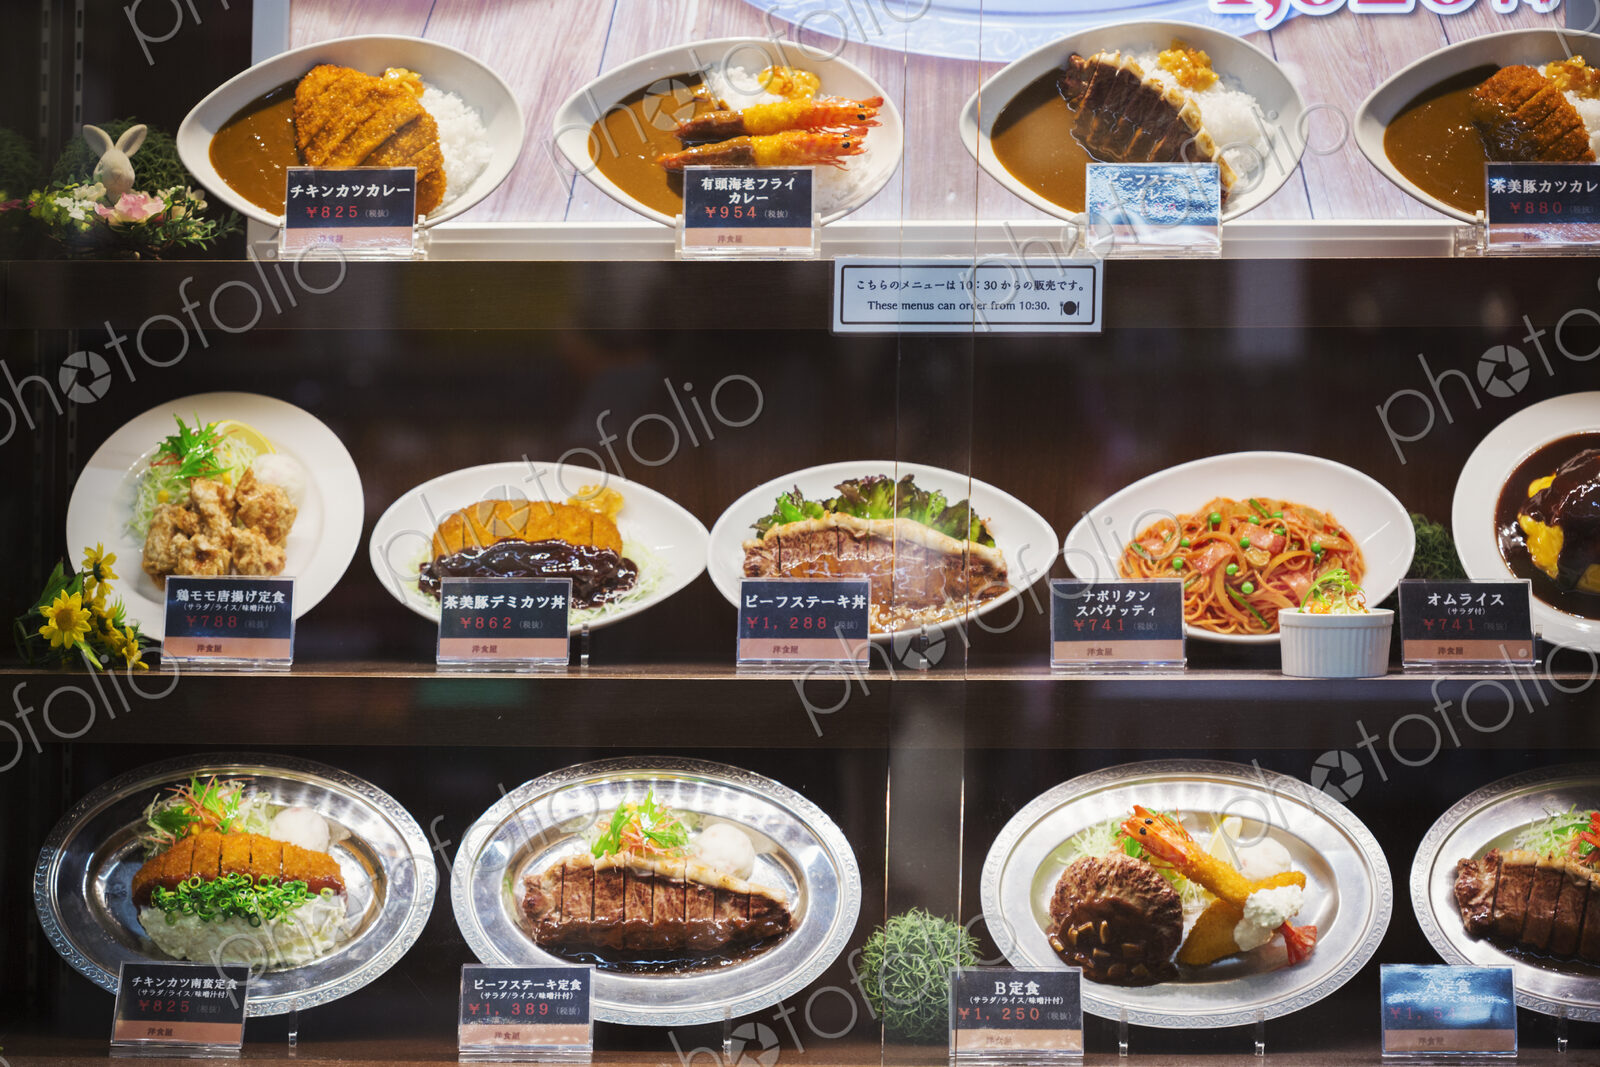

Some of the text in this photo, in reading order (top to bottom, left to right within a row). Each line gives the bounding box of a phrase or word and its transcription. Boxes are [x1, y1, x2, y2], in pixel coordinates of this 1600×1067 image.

[701, 177, 795, 191] 有頭海老フライ
[290, 184, 411, 198] チキンカツカレー
[729, 192, 769, 204] カレー
[306, 206, 358, 218] ¥825
[705, 206, 757, 219] ¥954
[1510, 202, 1562, 214] ¥880
[867, 301, 1050, 311] These menus can order from 10:30.
[176, 588, 286, 604] 鶏モモ唐揚げ定食
[444, 595, 566, 609] 茶美豚デミカツ丼
[745, 594, 867, 609] ビーフステーキ丼
[1083, 590, 1151, 602] ナポリタン
[1427, 592, 1505, 606] オムライス
[1076, 604, 1156, 617] スパゲッティ
[186, 615, 238, 629] ¥788
[461, 617, 512, 629] ¥862
[1073, 619, 1124, 632] ¥741
[1424, 618, 1476, 631] ¥741
[131, 976, 238, 990] チキンカツ南蛮定食
[474, 979, 582, 991] ビーフステーキ定食
[994, 980, 1040, 996] B定食
[139, 1000, 190, 1013] ¥825
